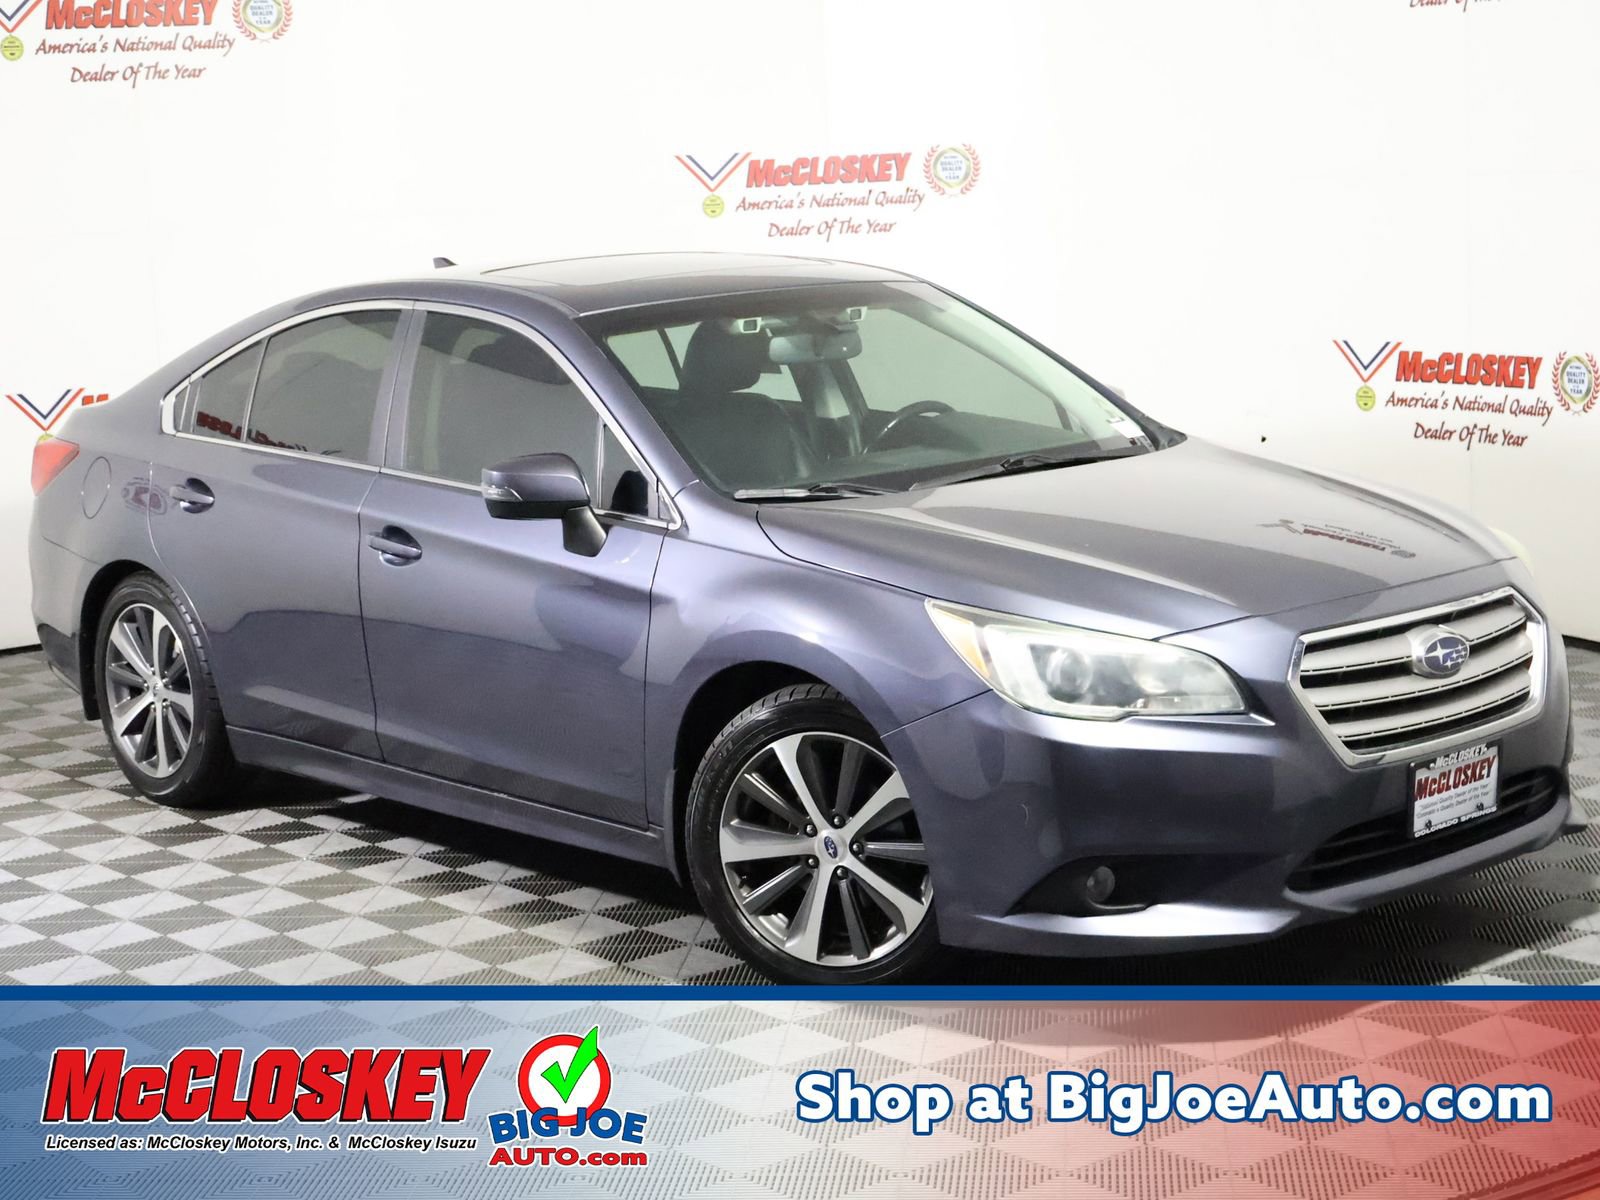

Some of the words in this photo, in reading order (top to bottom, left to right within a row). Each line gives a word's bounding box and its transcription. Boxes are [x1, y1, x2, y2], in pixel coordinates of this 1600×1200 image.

[45, 0, 218, 30] McCLOSKEY
[35, 35, 108, 56] America's
[113, 32, 179, 53] National
[182, 31, 236, 57] Quality
[70, 64, 119, 83] Dealer
[122, 62, 143, 89] Of
[144, 62, 169, 81] The
[174, 64, 207, 80] Year
[746, 152, 911, 188] McCLOSKEY
[735, 192, 805, 212] America's
[810, 188, 871, 210] National
[874, 187, 926, 212] Quality
[767, 219, 814, 238] Dealer
[817, 218, 838, 242] Of
[839, 217, 862, 235] The
[866, 218, 897, 234] Year
[1395, 351, 1543, 389] McCLOSKEY
[1385, 391, 1449, 410] America's
[1452, 394, 1506, 414] National
[1509, 397, 1554, 426] Quality
[1414, 422, 1456, 441] Dealer
[1459, 423, 1478, 451] Of
[1478, 426, 1500, 446] The
[1502, 429, 1528, 448] Year
[1435, 743, 1487, 768] McCLOSKEY
[1414, 755, 1497, 801] McCLOSKEY
[1414, 818, 1459, 838] COLORADO
[1460, 805, 1498, 822] SPRINGS
